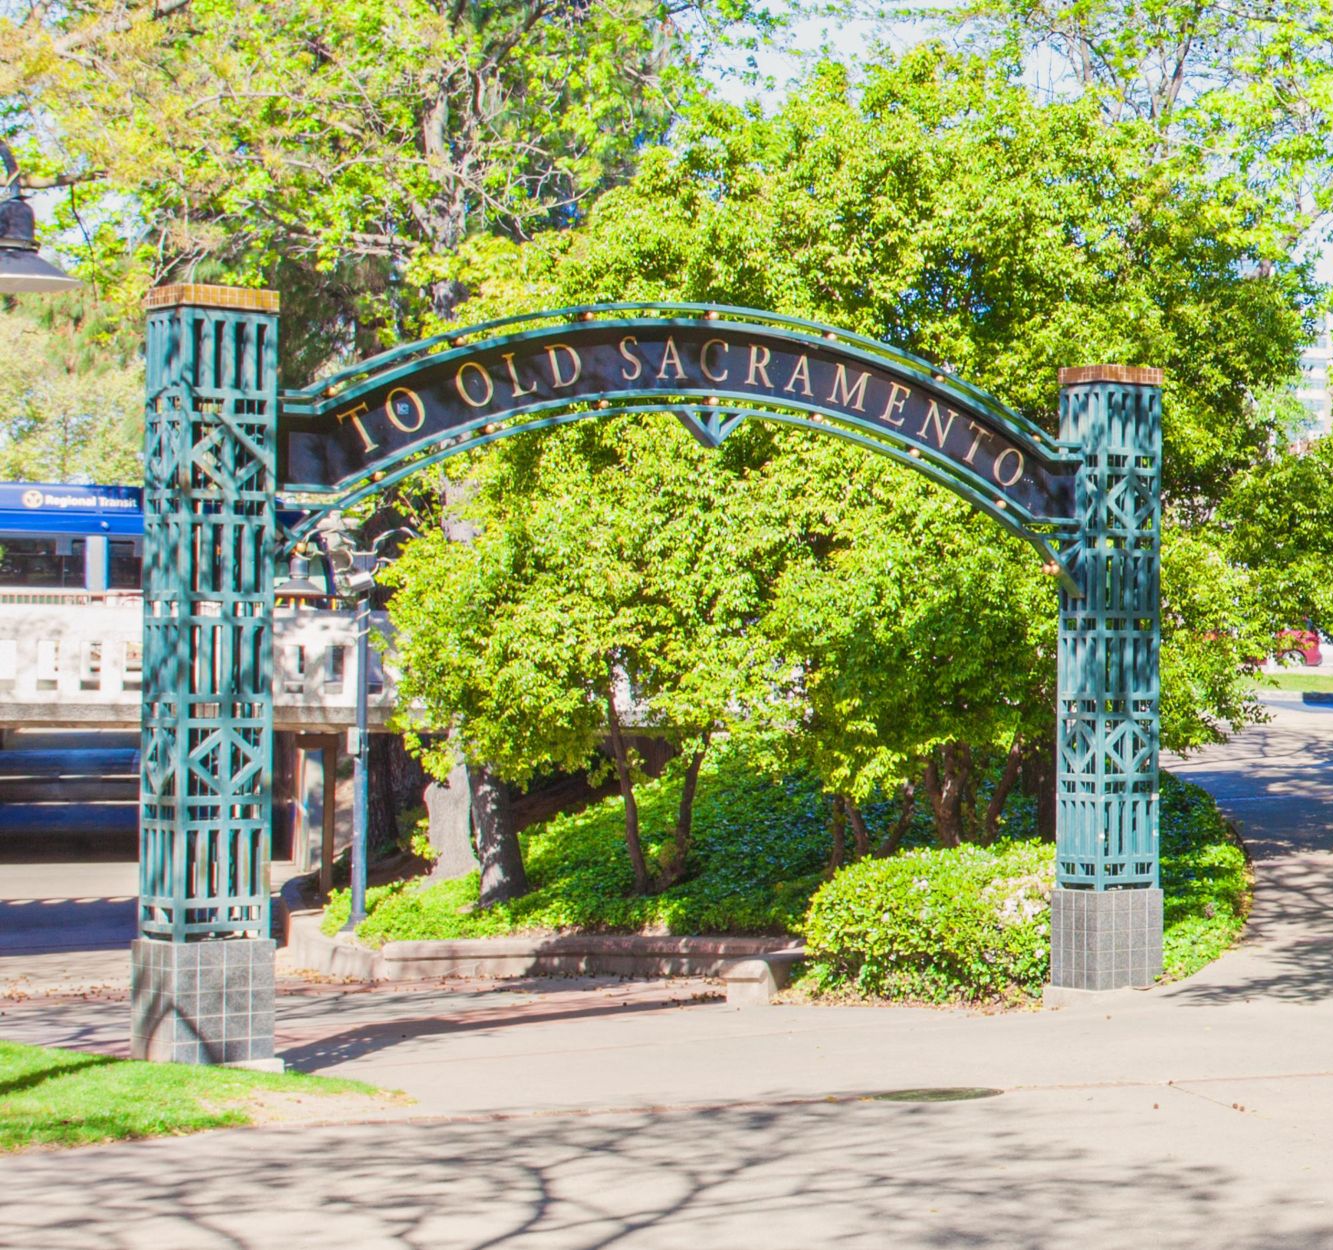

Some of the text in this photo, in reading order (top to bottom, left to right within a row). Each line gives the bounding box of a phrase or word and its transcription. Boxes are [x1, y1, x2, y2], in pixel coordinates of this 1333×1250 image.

[336, 335, 1025, 487] TO OLD SACRAMENTO
[45, 494, 138, 508] Regional Transit
